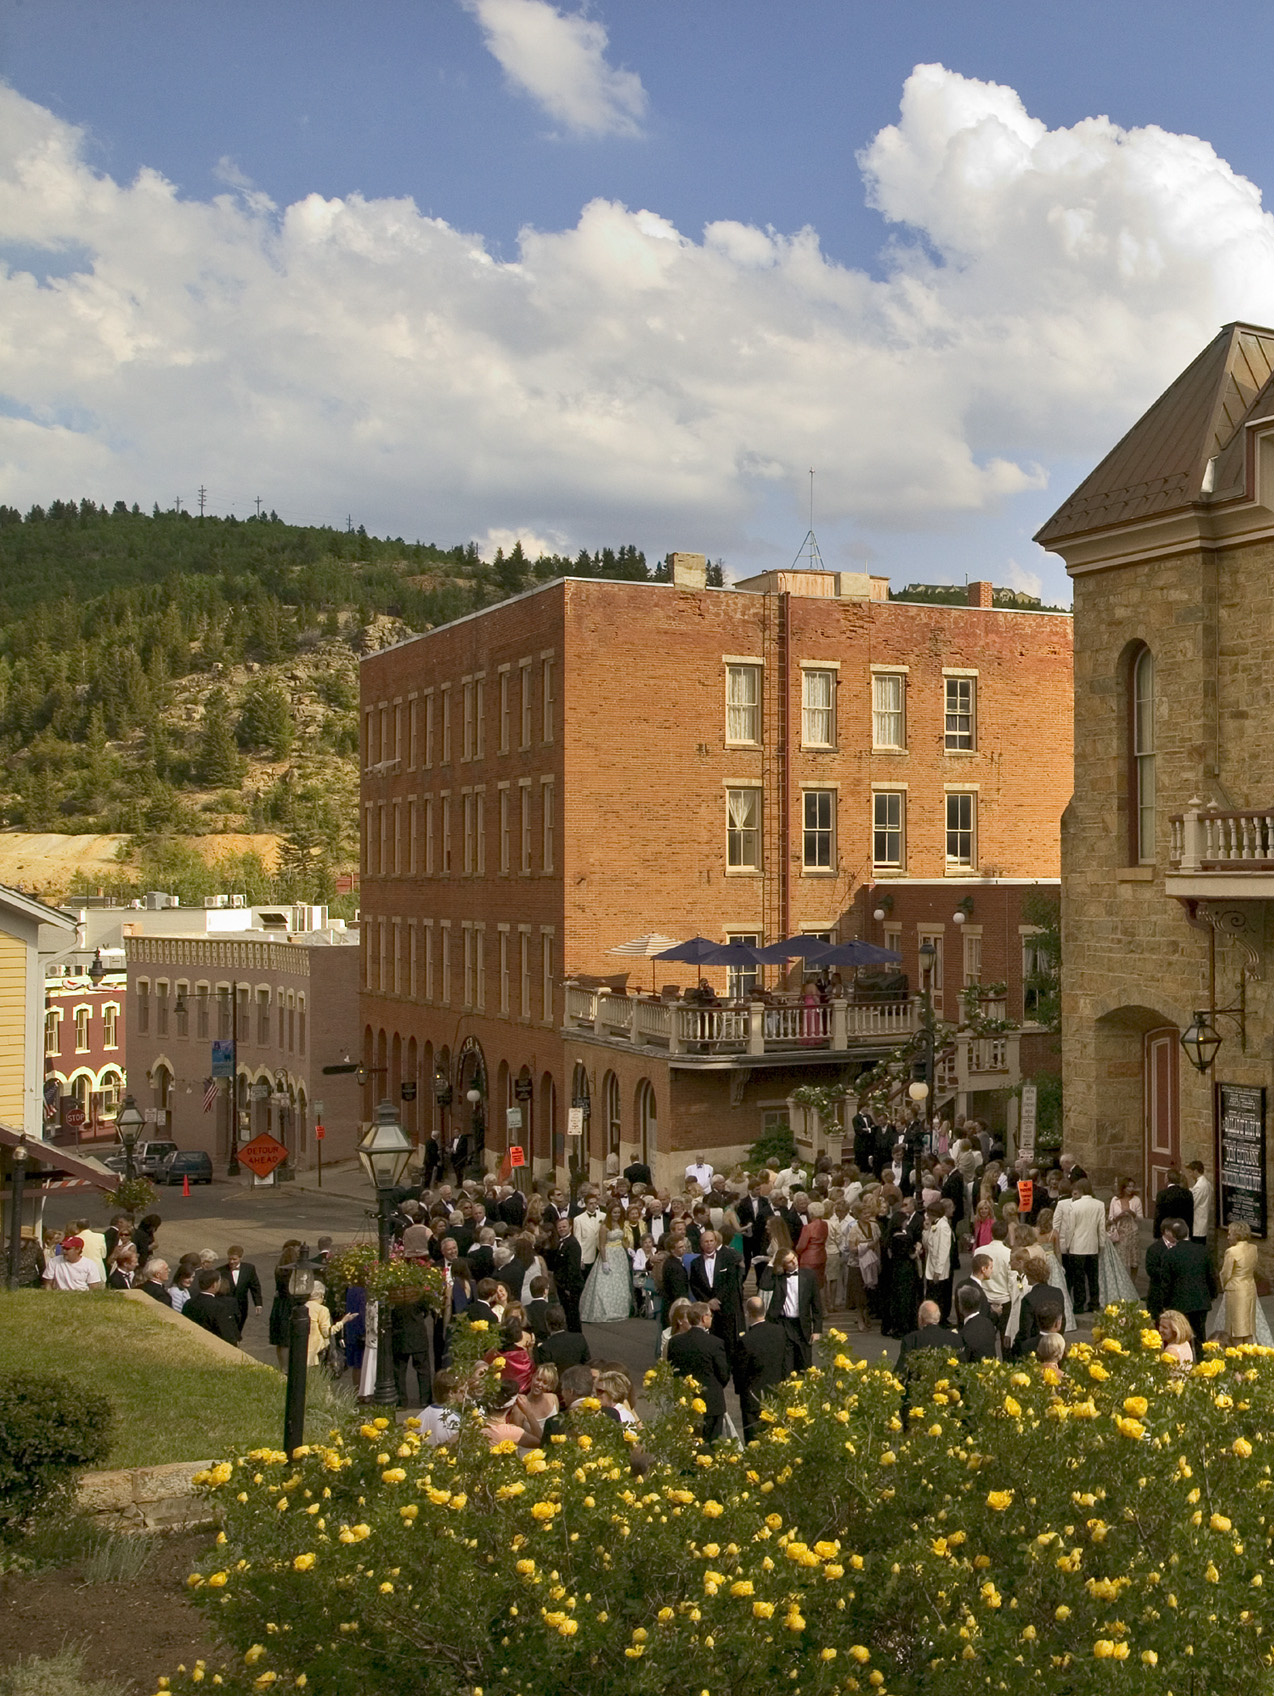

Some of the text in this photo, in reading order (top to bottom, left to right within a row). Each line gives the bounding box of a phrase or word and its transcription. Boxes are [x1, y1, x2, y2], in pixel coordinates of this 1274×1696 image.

[67, 1113, 85, 1122] STOP
[247, 1146, 279, 1155] DETOUR
[248, 1156, 278, 1164] AHEAD
